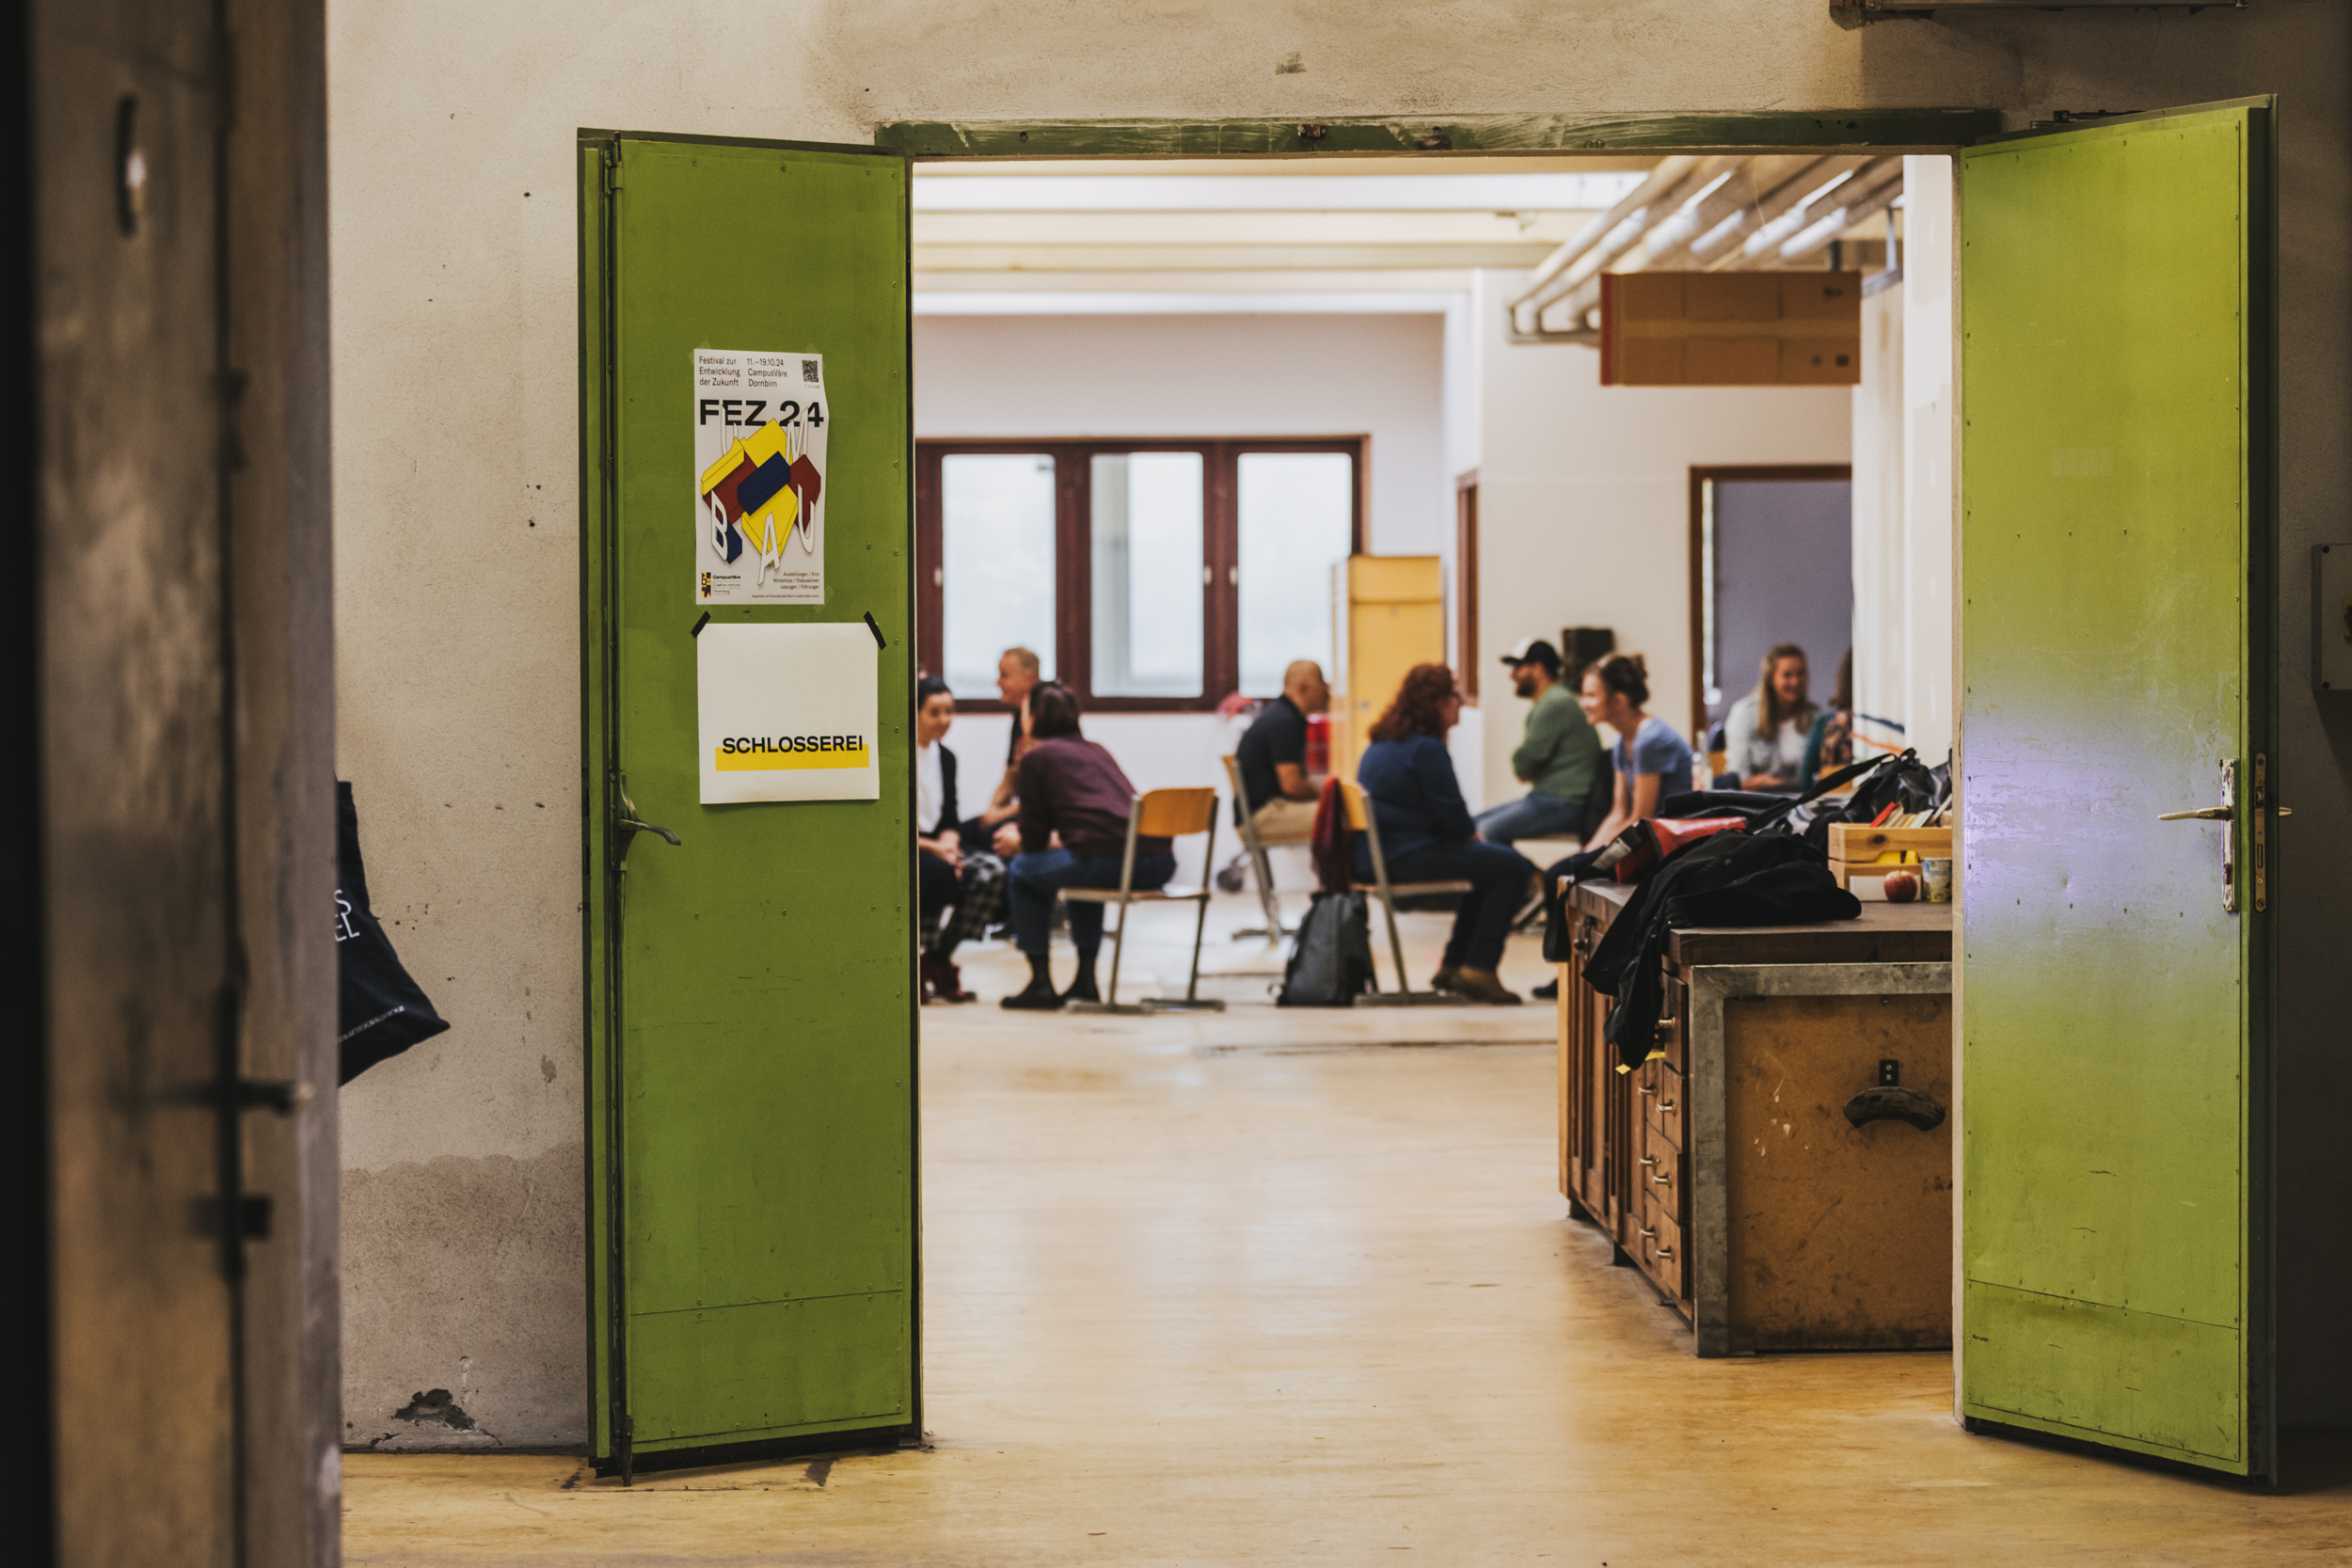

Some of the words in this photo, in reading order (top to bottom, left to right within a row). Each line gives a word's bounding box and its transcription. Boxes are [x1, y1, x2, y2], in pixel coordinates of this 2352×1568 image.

[699, 356, 724, 365] Festival
[699, 367, 740, 377] Entwicklung
[748, 368, 787, 378] CampusVäre
[712, 378, 739, 387] Zukunft
[748, 379, 777, 388] Dornbirn
[700, 399, 767, 426] FEZ
[779, 400, 824, 427] 24
[723, 736, 863, 754] SCHLOSSEREI
